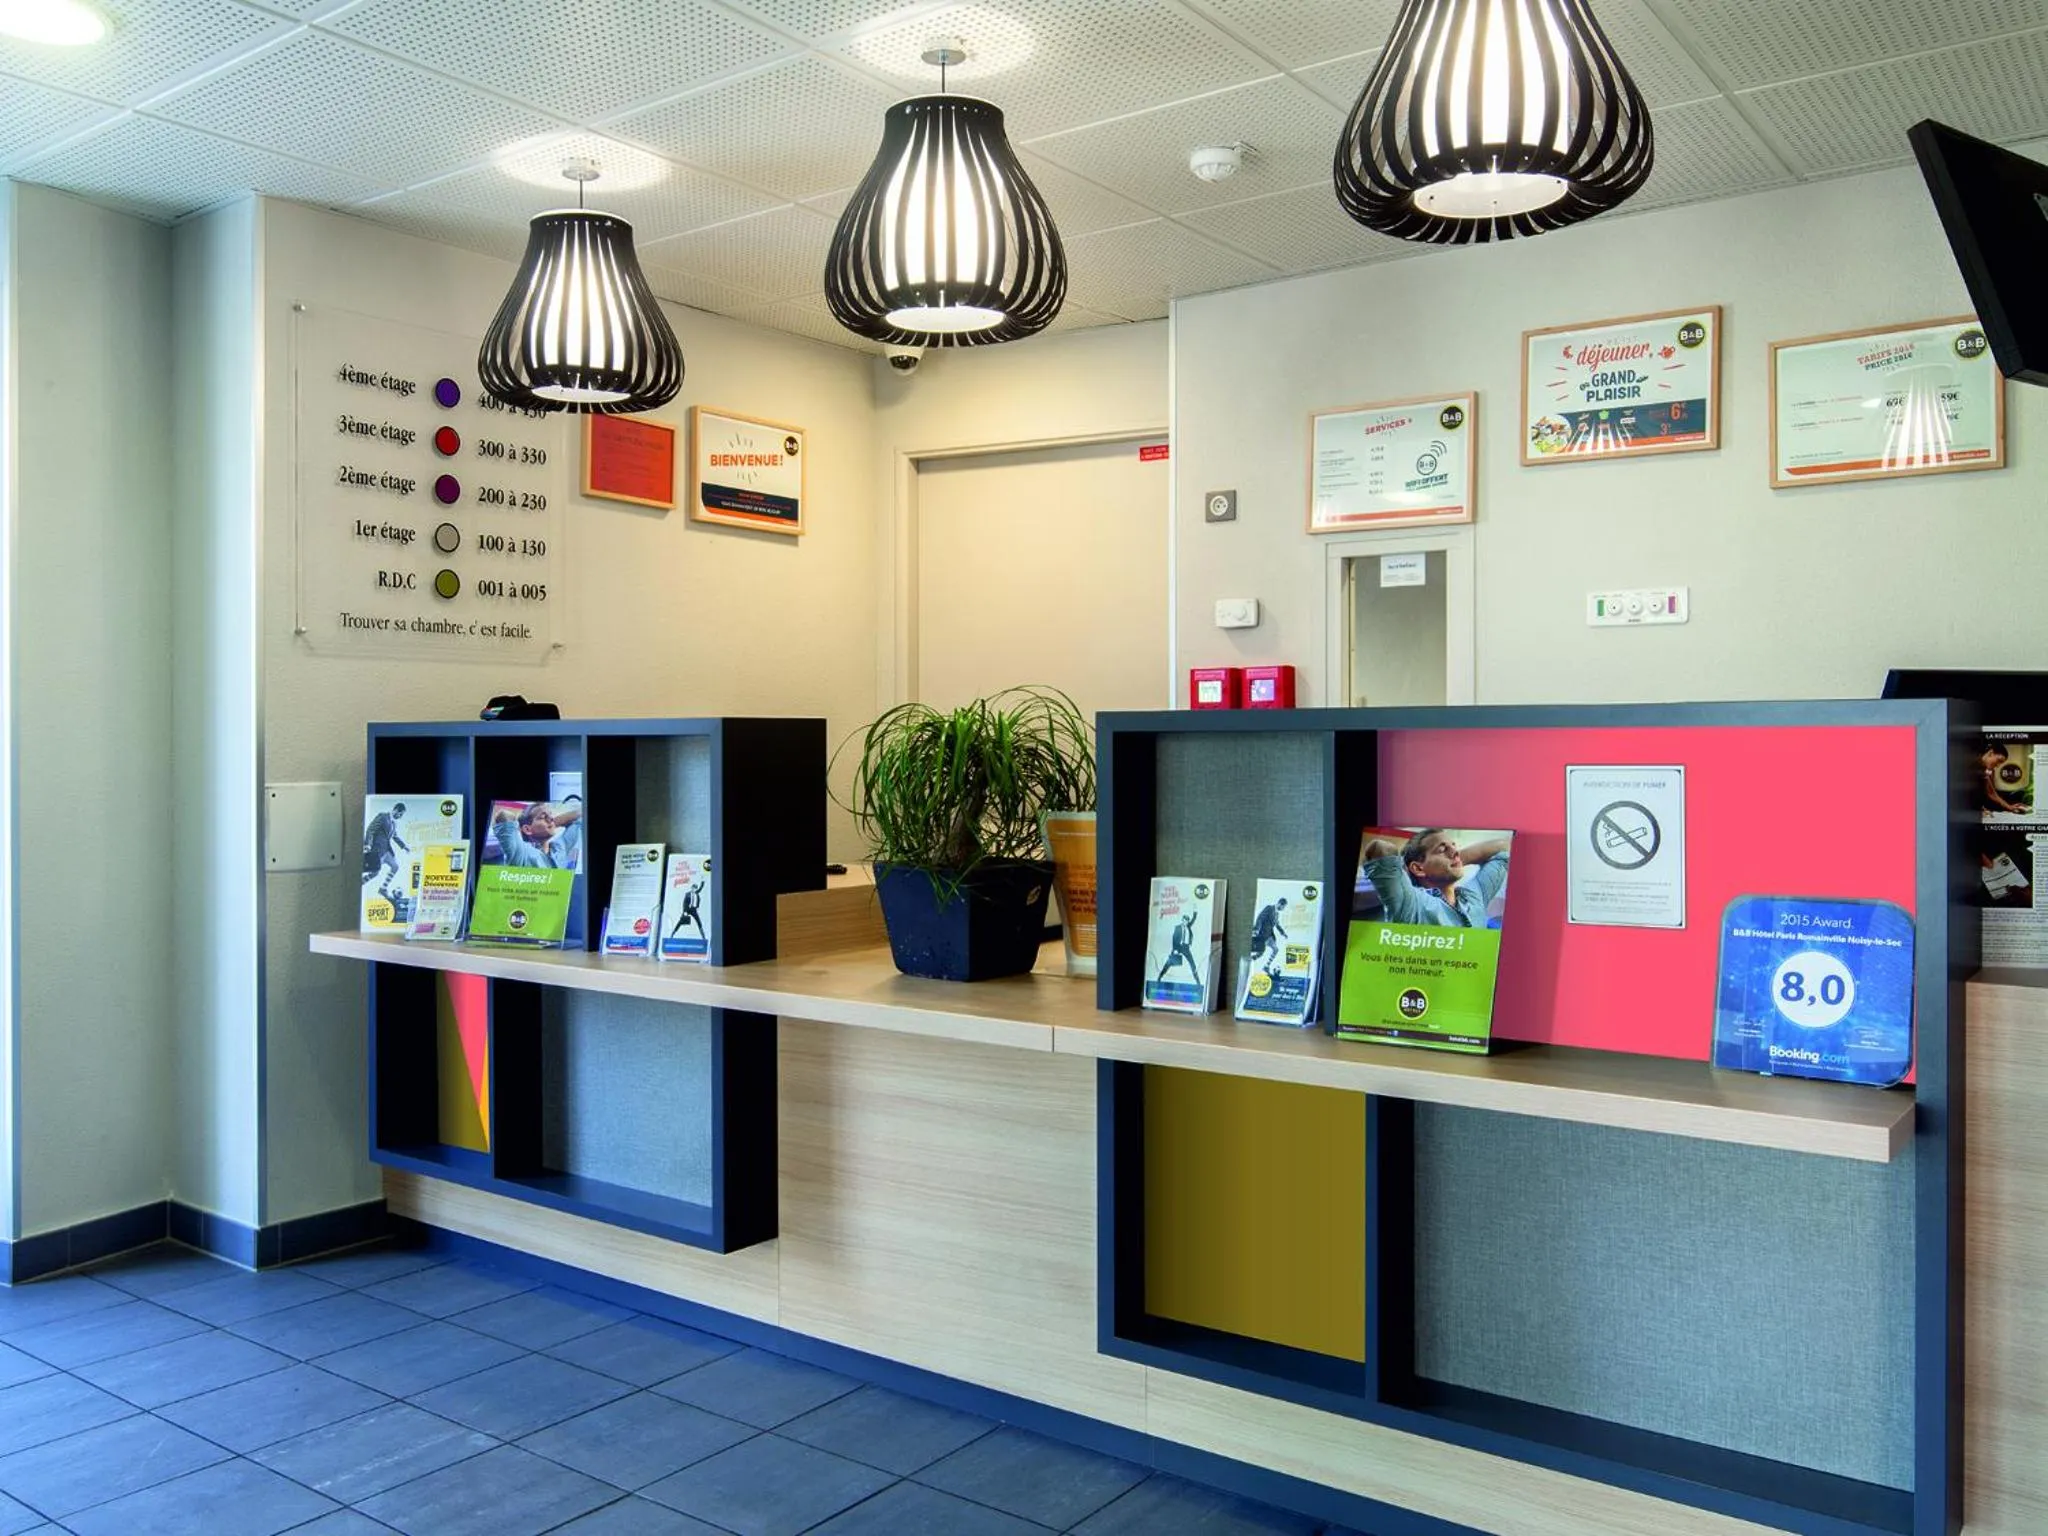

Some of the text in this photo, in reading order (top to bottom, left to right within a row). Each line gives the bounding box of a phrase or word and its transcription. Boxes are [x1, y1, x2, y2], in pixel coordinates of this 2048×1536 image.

[1680, 329, 1704, 341] B&B
[1958, 338, 1985, 350] B&B
[339, 363, 416, 397] 4ème étage
[1592, 369, 1636, 388] GRAND
[1586, 385, 1641, 402] PLAISIR
[339, 414, 416, 446] 3ème étage
[1364, 418, 1406, 435] SERVICES
[478, 439, 546, 465] 300 à 330
[339, 466, 416, 495] 2ème étage
[478, 486, 546, 511] 200 à 230
[356, 519, 416, 545] 1er étage
[478, 534, 546, 556] 100 à 130
[378, 570, 416, 590] R.D.C
[478, 580, 546, 601] 001 à 005
[340, 612, 389, 631] Trouver
[394, 620, 407, 632] sa
[410, 616, 466, 636] chambre,
[500, 622, 532, 639] facile.
[1780, 914, 1810, 926] 2015
[1776, 932, 1796, 940] Paris
[1797, 932, 1846, 943] Romainville
[1848, 936, 1902, 947] Noisy-le-Sec
[1360, 952, 1479, 970] Vous êtes dans un espace
[1388, 966, 1405, 974] non
[1780, 972, 1846, 1006] 8,0
[1401, 996, 1425, 1010] B&B
